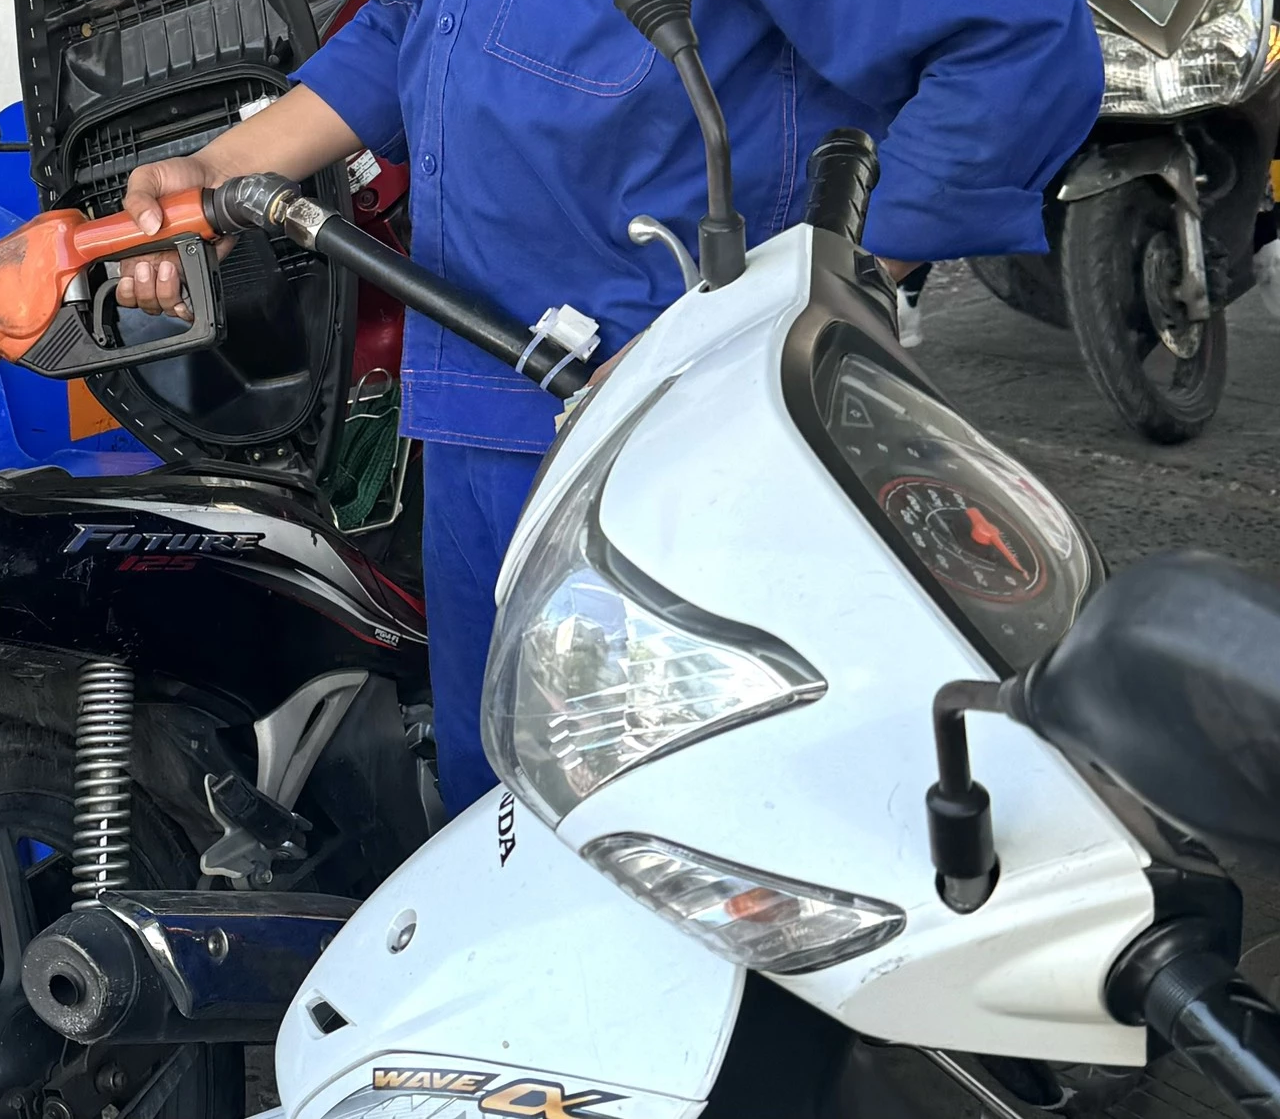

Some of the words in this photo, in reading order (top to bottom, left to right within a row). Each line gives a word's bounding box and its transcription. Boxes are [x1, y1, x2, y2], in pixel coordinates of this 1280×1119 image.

[62, 522, 265, 554] FUTURE
[117, 554, 201, 572] 125
[374, 1069, 487, 1092] WAVE
